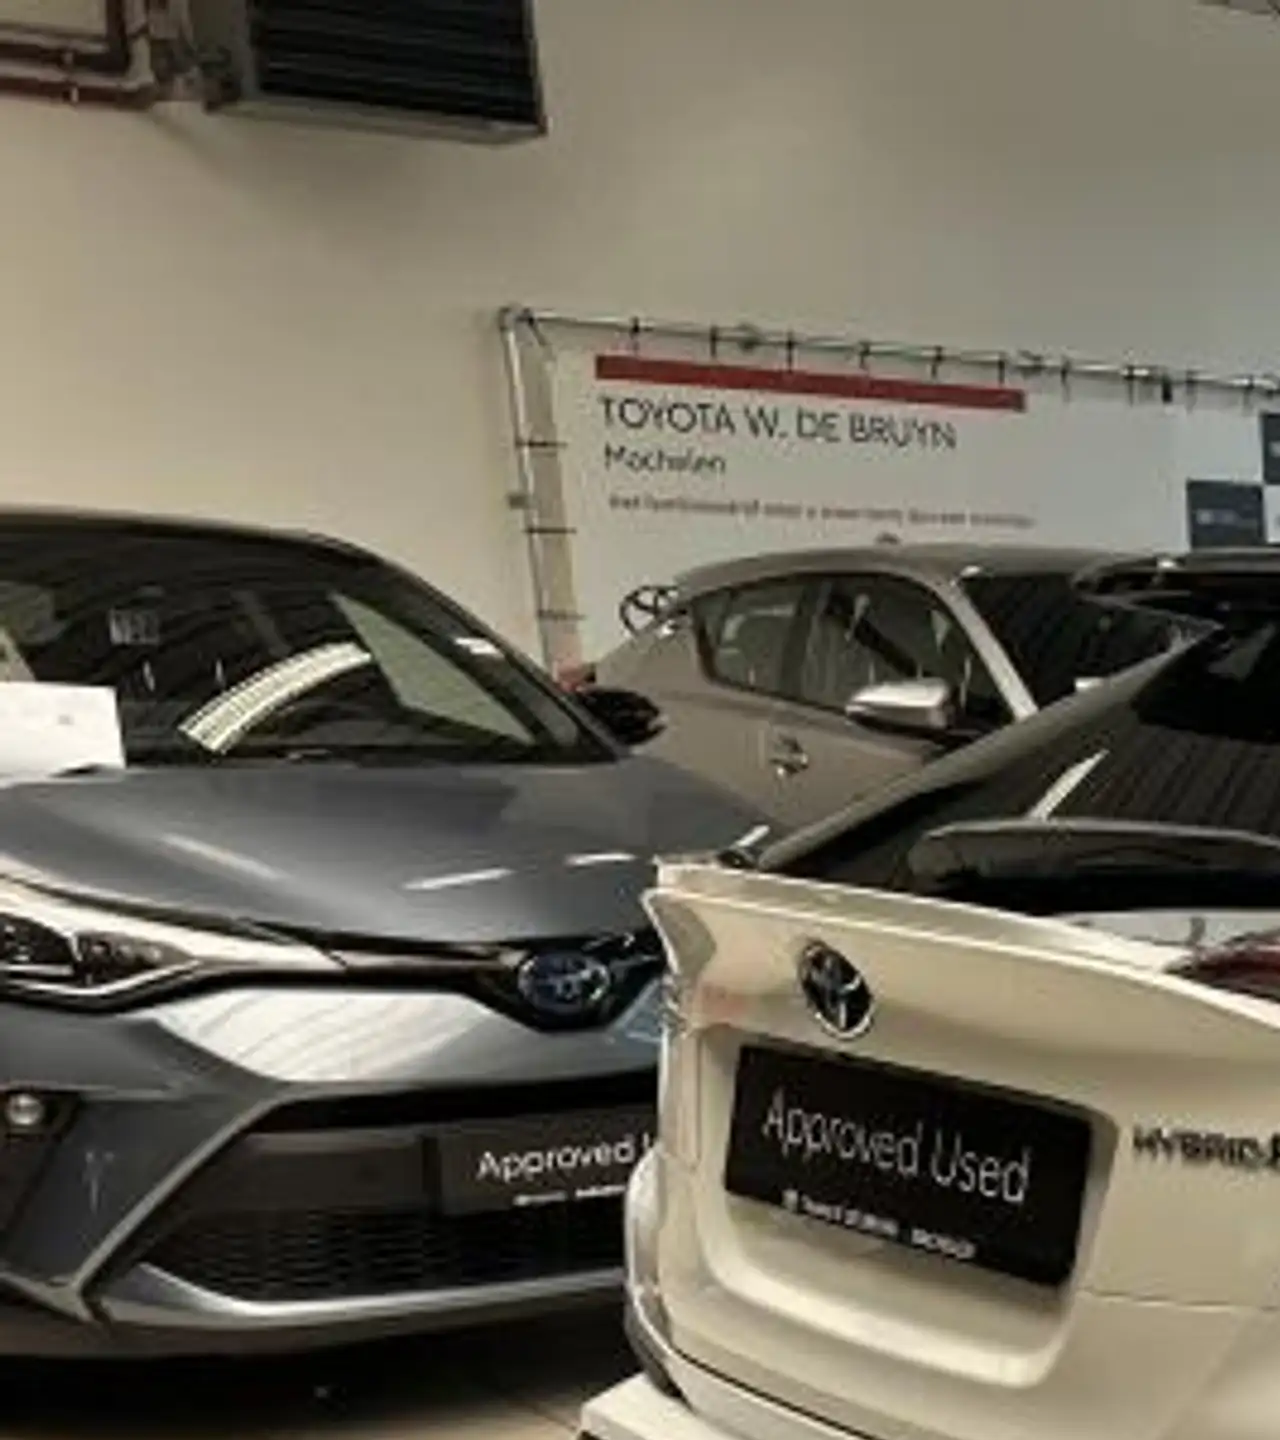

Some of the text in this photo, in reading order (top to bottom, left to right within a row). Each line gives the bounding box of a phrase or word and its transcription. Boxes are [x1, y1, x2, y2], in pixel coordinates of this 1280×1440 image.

[601, 396, 957, 449] TOYOTA W. DE BRUYN
[475, 1132, 636, 1184] Approved
[762, 1085, 1032, 1205] Approved Used
